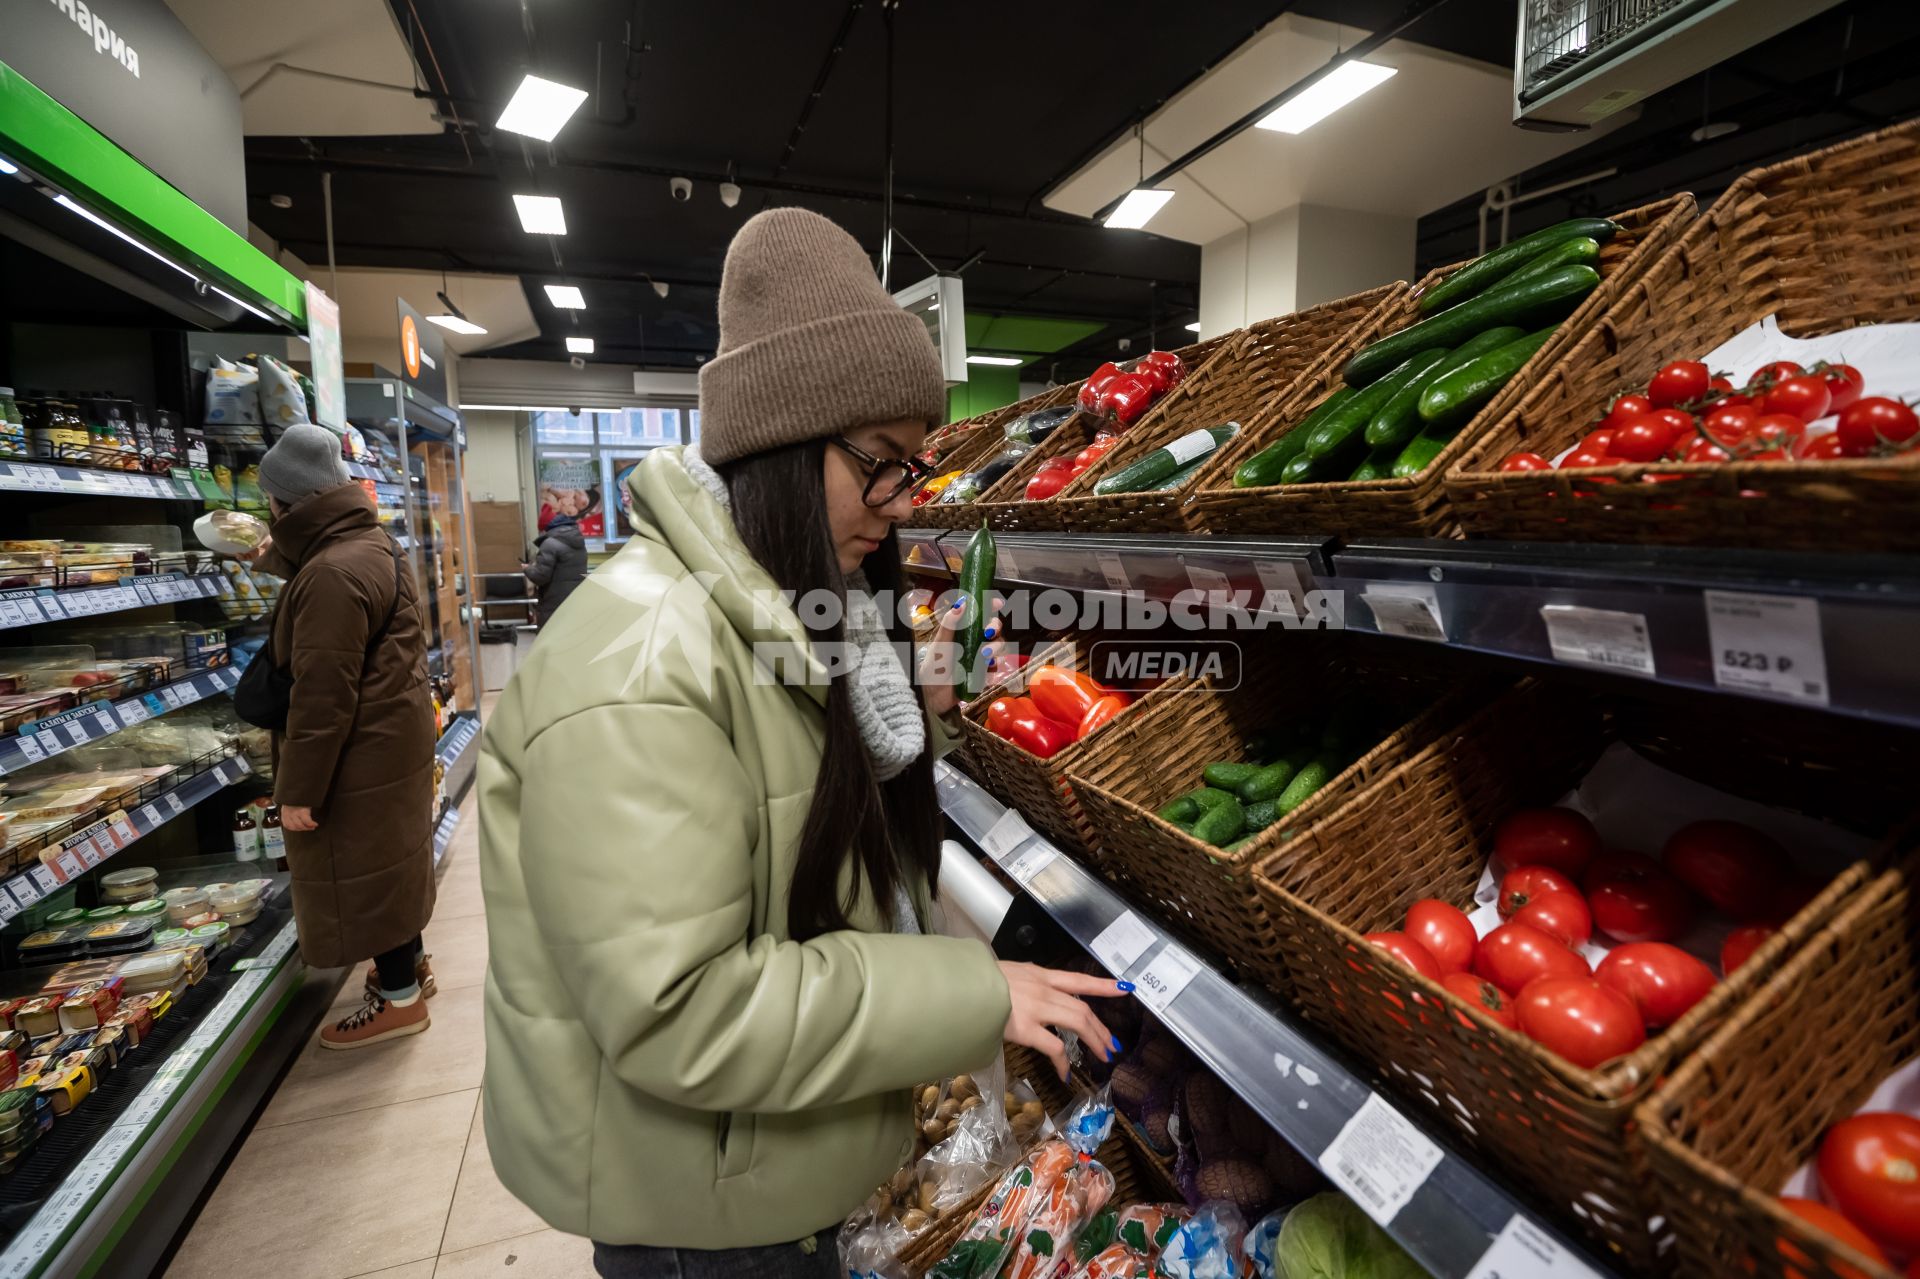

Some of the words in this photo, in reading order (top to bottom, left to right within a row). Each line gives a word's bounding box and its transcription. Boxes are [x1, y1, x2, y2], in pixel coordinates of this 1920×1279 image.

[50, 0, 140, 79] нария
[1724, 649, 1769, 672] 523
[40, 715, 66, 729] САЛАТЫ
[71, 705, 98, 719] ЗАКУСКИ
[64, 831, 88, 848] ВТОРЫЕ
[87, 821, 108, 836] БЛЮДА
[1142, 972, 1161, 989] 550
